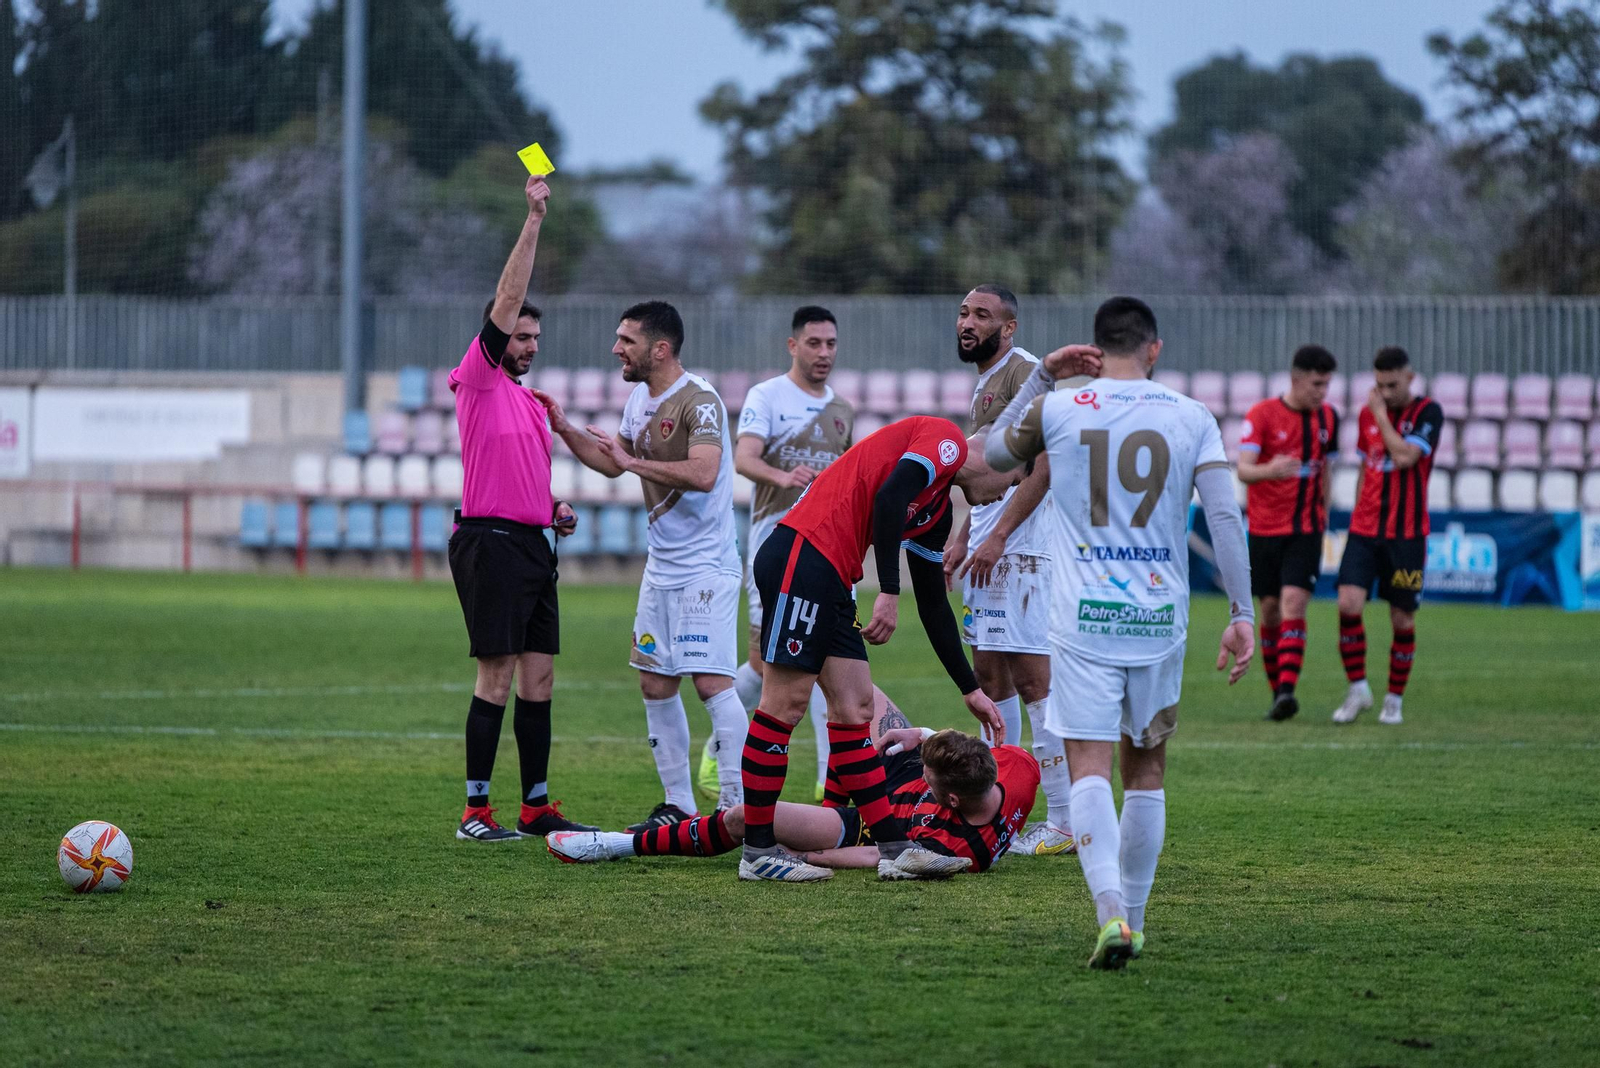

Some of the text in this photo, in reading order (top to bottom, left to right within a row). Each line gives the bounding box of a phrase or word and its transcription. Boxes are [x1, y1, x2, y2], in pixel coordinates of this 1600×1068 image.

[1080, 429, 1170, 528] 19
[1093, 545, 1171, 562] TAMESUR
[788, 595, 820, 636] 14
[1080, 603, 1175, 624] Petro Markt
